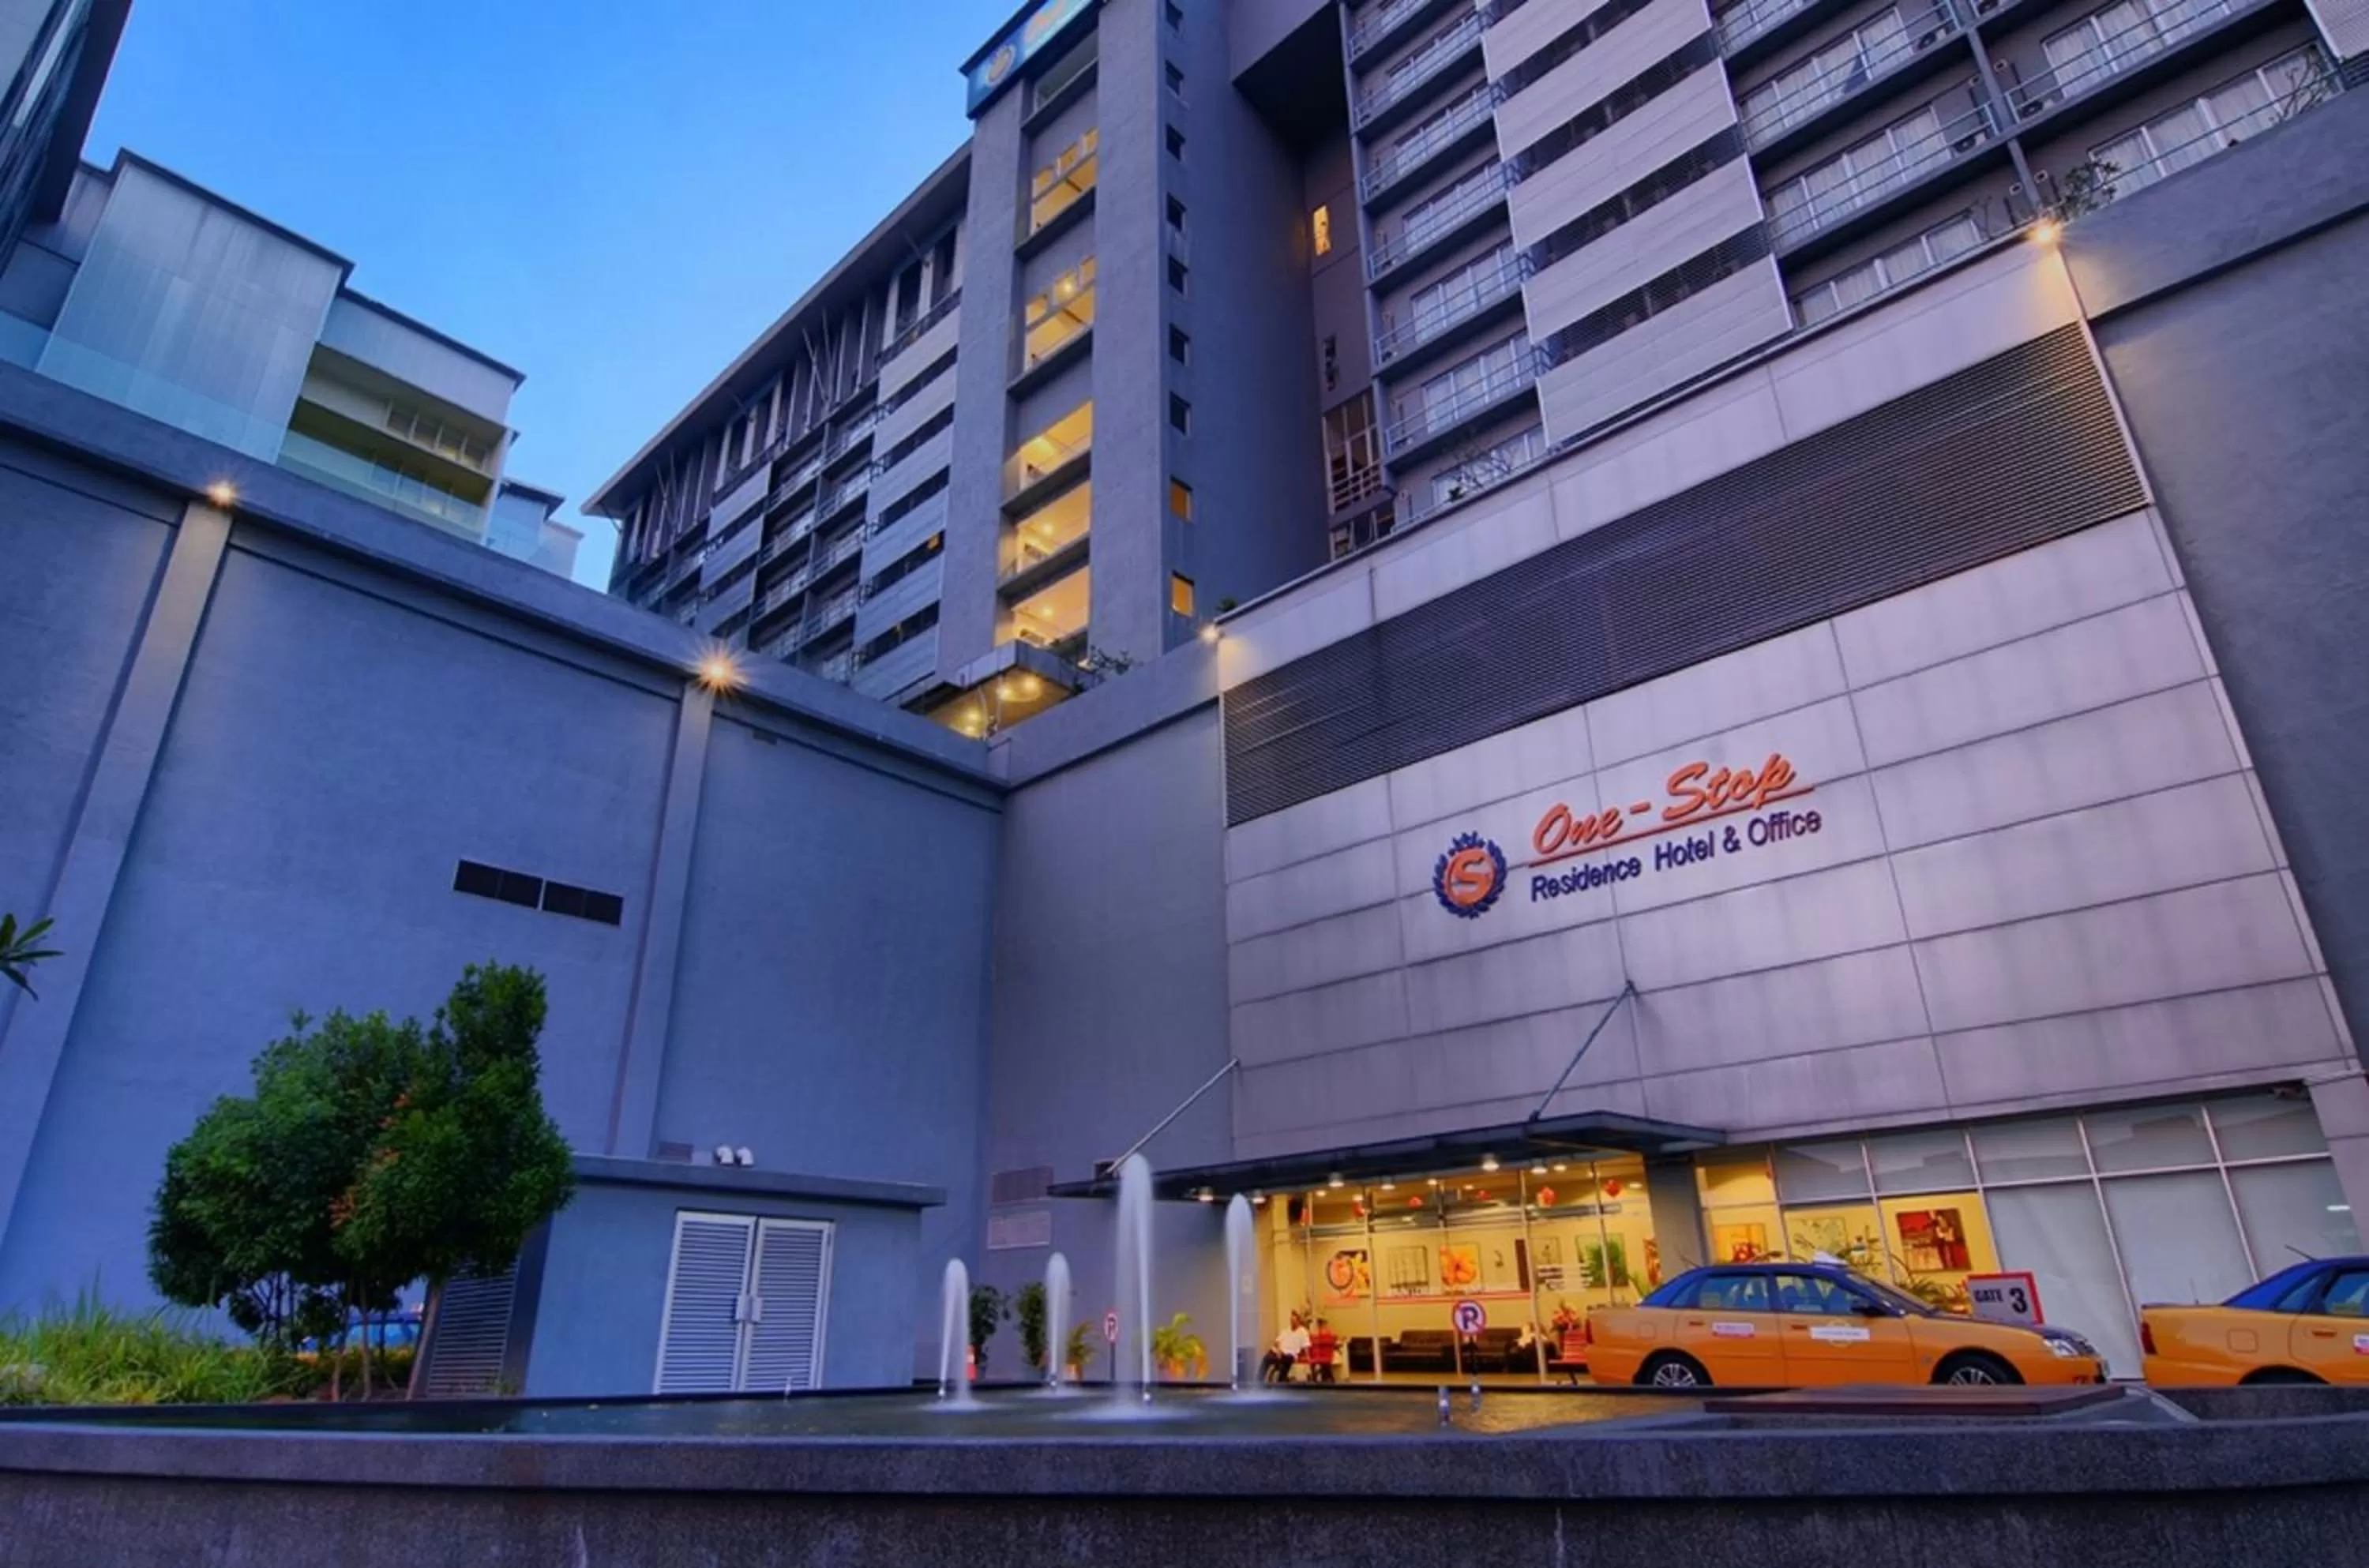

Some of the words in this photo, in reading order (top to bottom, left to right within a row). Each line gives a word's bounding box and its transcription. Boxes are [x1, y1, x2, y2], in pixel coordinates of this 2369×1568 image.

[1531, 855, 1642, 902] Residence
[1654, 831, 1715, 872] Hotel
[1723, 826, 1742, 853] &
[1748, 809, 1823, 847] Office
[1974, 1288, 2004, 1303] GATE
[2009, 1287, 2028, 1314] 3
